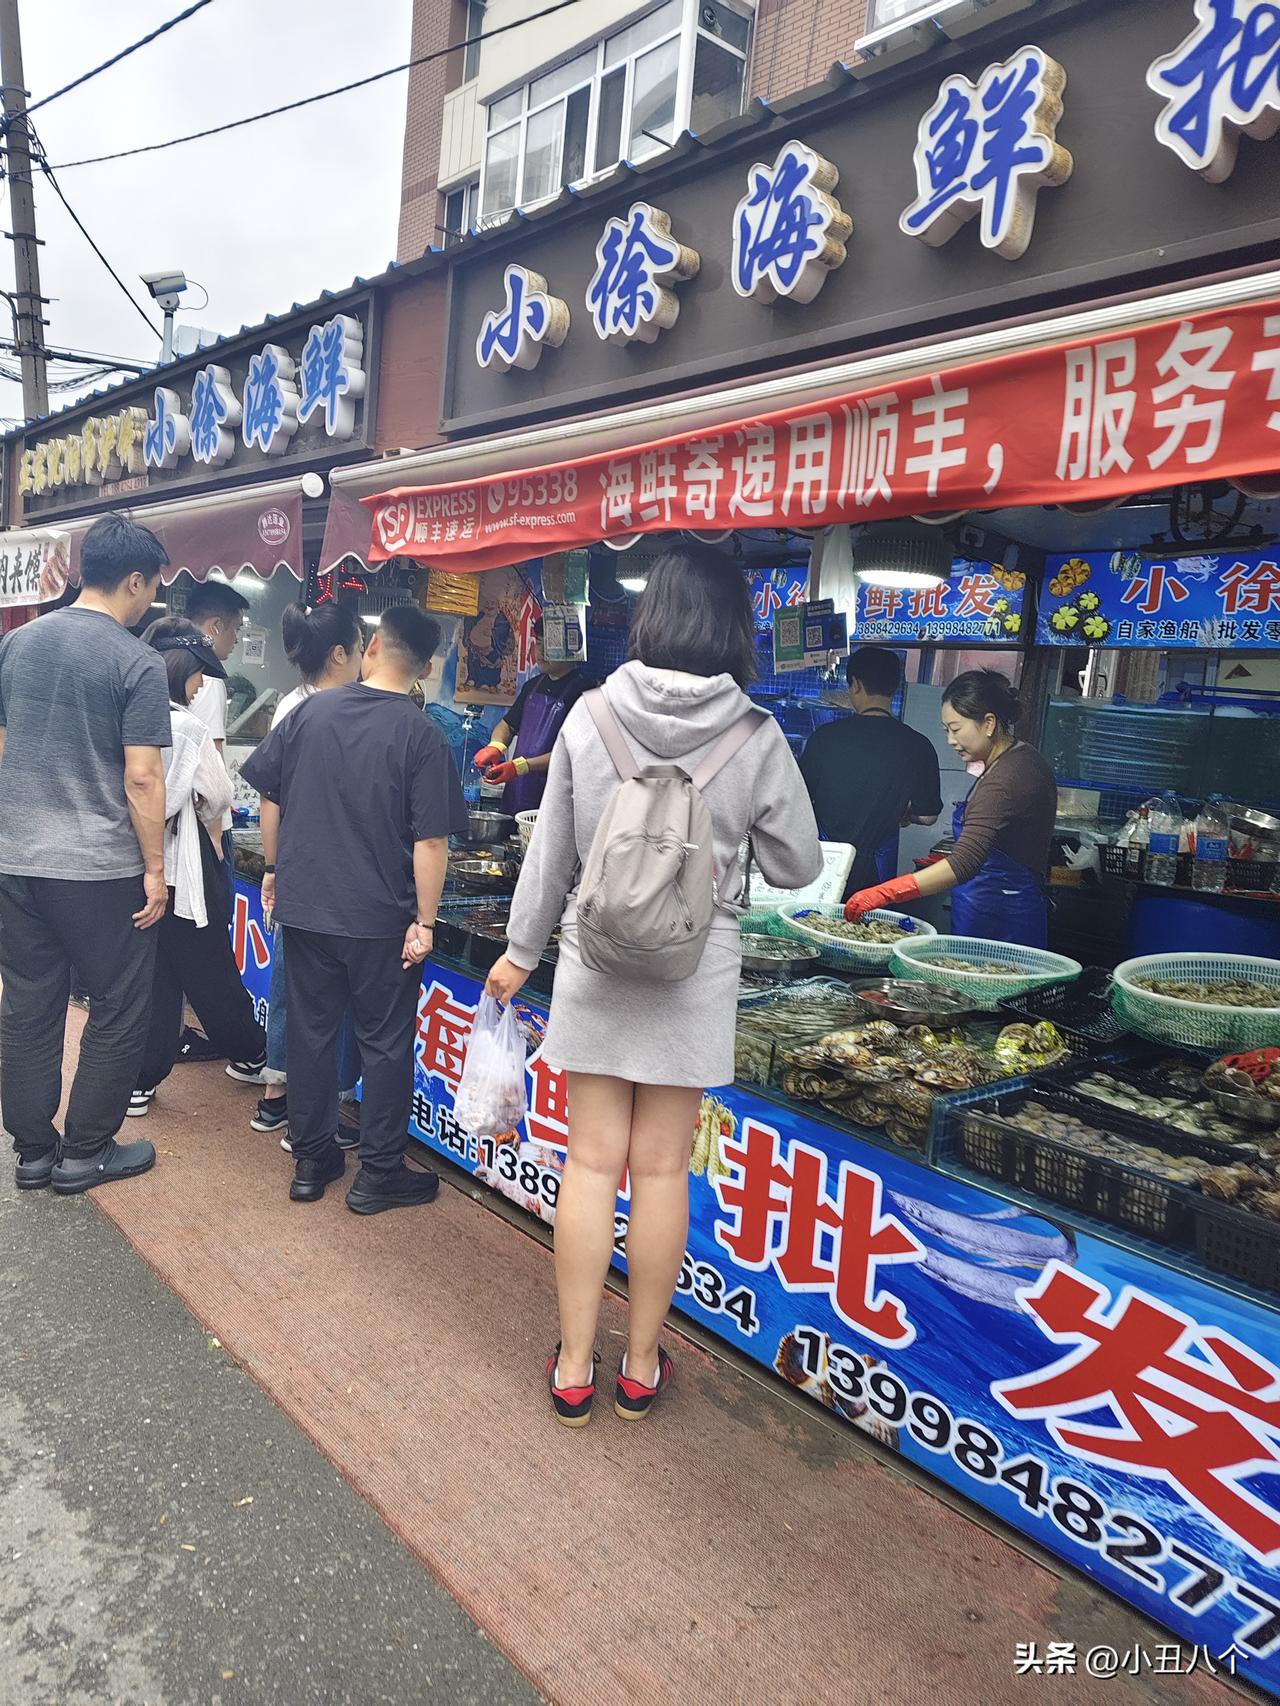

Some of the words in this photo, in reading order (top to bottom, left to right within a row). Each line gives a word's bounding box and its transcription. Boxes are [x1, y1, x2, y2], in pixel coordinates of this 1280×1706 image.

[144, 314, 352, 468] 小徐海鲜
[508, 468, 578, 506] 95338
[416, 489, 477, 518] EXPRESS
[414, 517, 475, 544] 顺丰速运
[484, 511, 576, 534] www.sf-express.com
[926, 621, 1001, 636] 13998482771
[1118, 620, 1200, 641] 自家渔船
